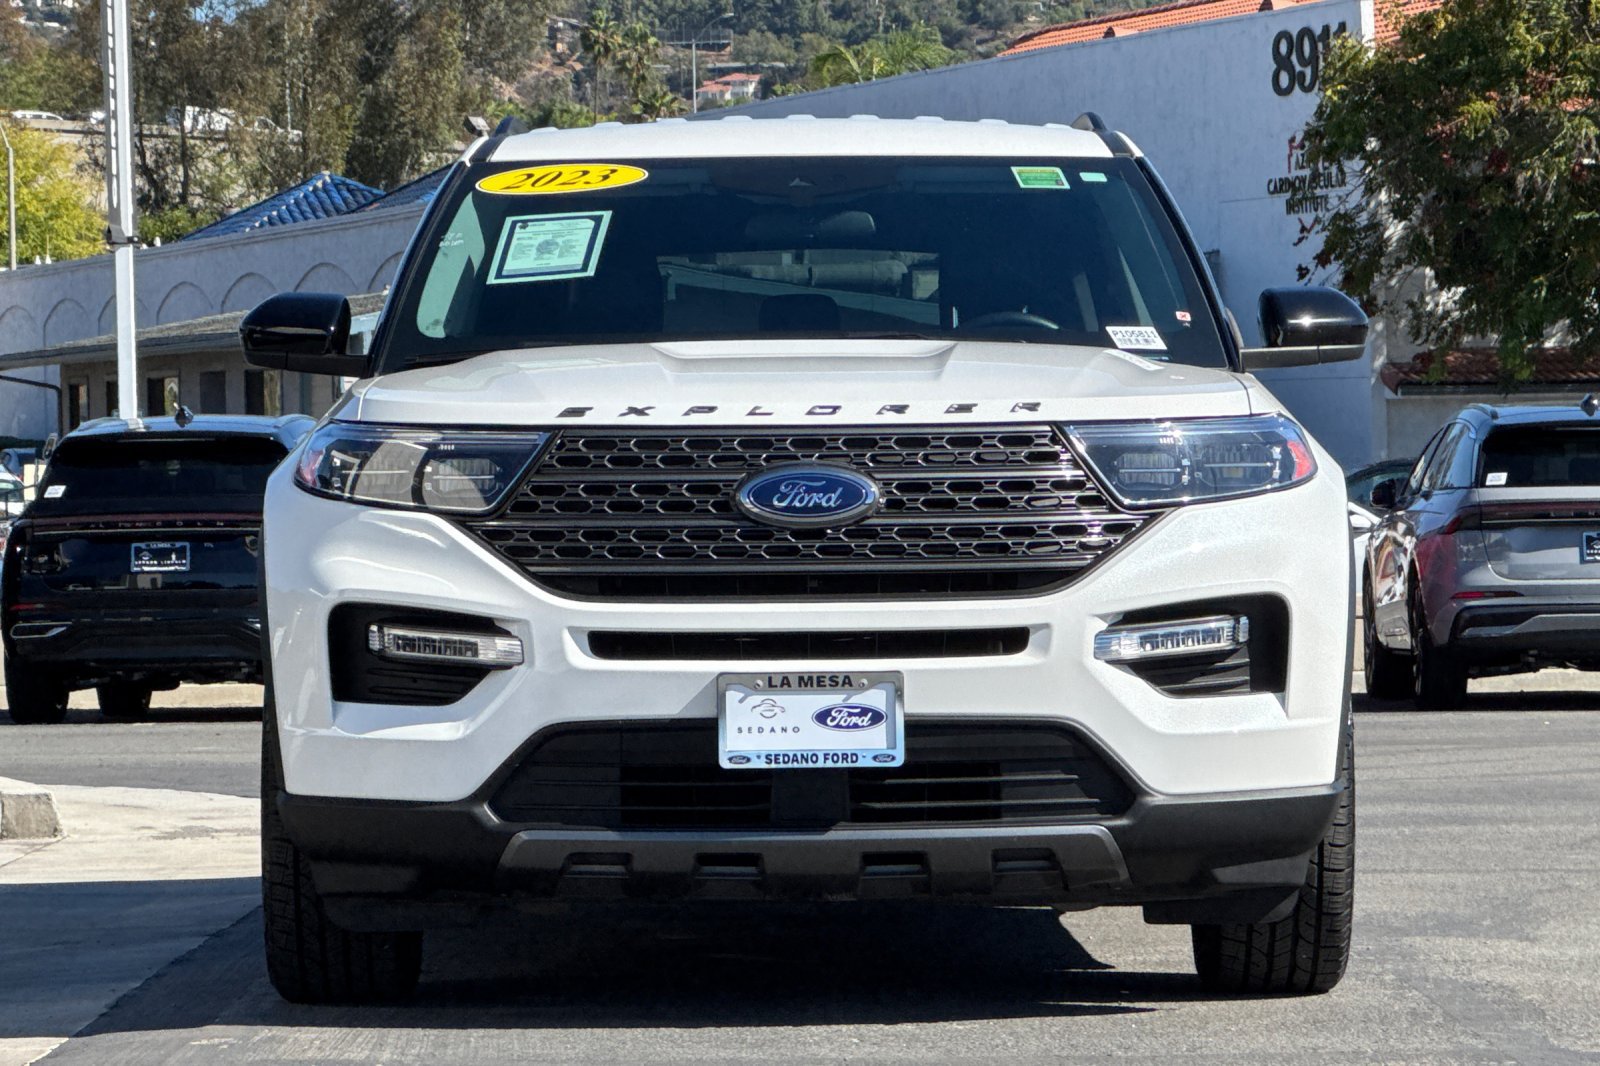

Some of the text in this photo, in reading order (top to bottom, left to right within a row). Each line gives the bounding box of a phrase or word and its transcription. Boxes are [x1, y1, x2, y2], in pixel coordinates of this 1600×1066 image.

[1272, 21, 1346, 96] 891
[500, 169, 618, 190] 2023
[555, 402, 1042, 418] EXPLORER
[772, 480, 843, 508] Ford
[767, 675, 853, 688] LA MESA
[826, 707, 873, 727] Ford
[737, 726, 800, 734] SEDANO
[765, 753, 858, 765] SEDANO FORD
